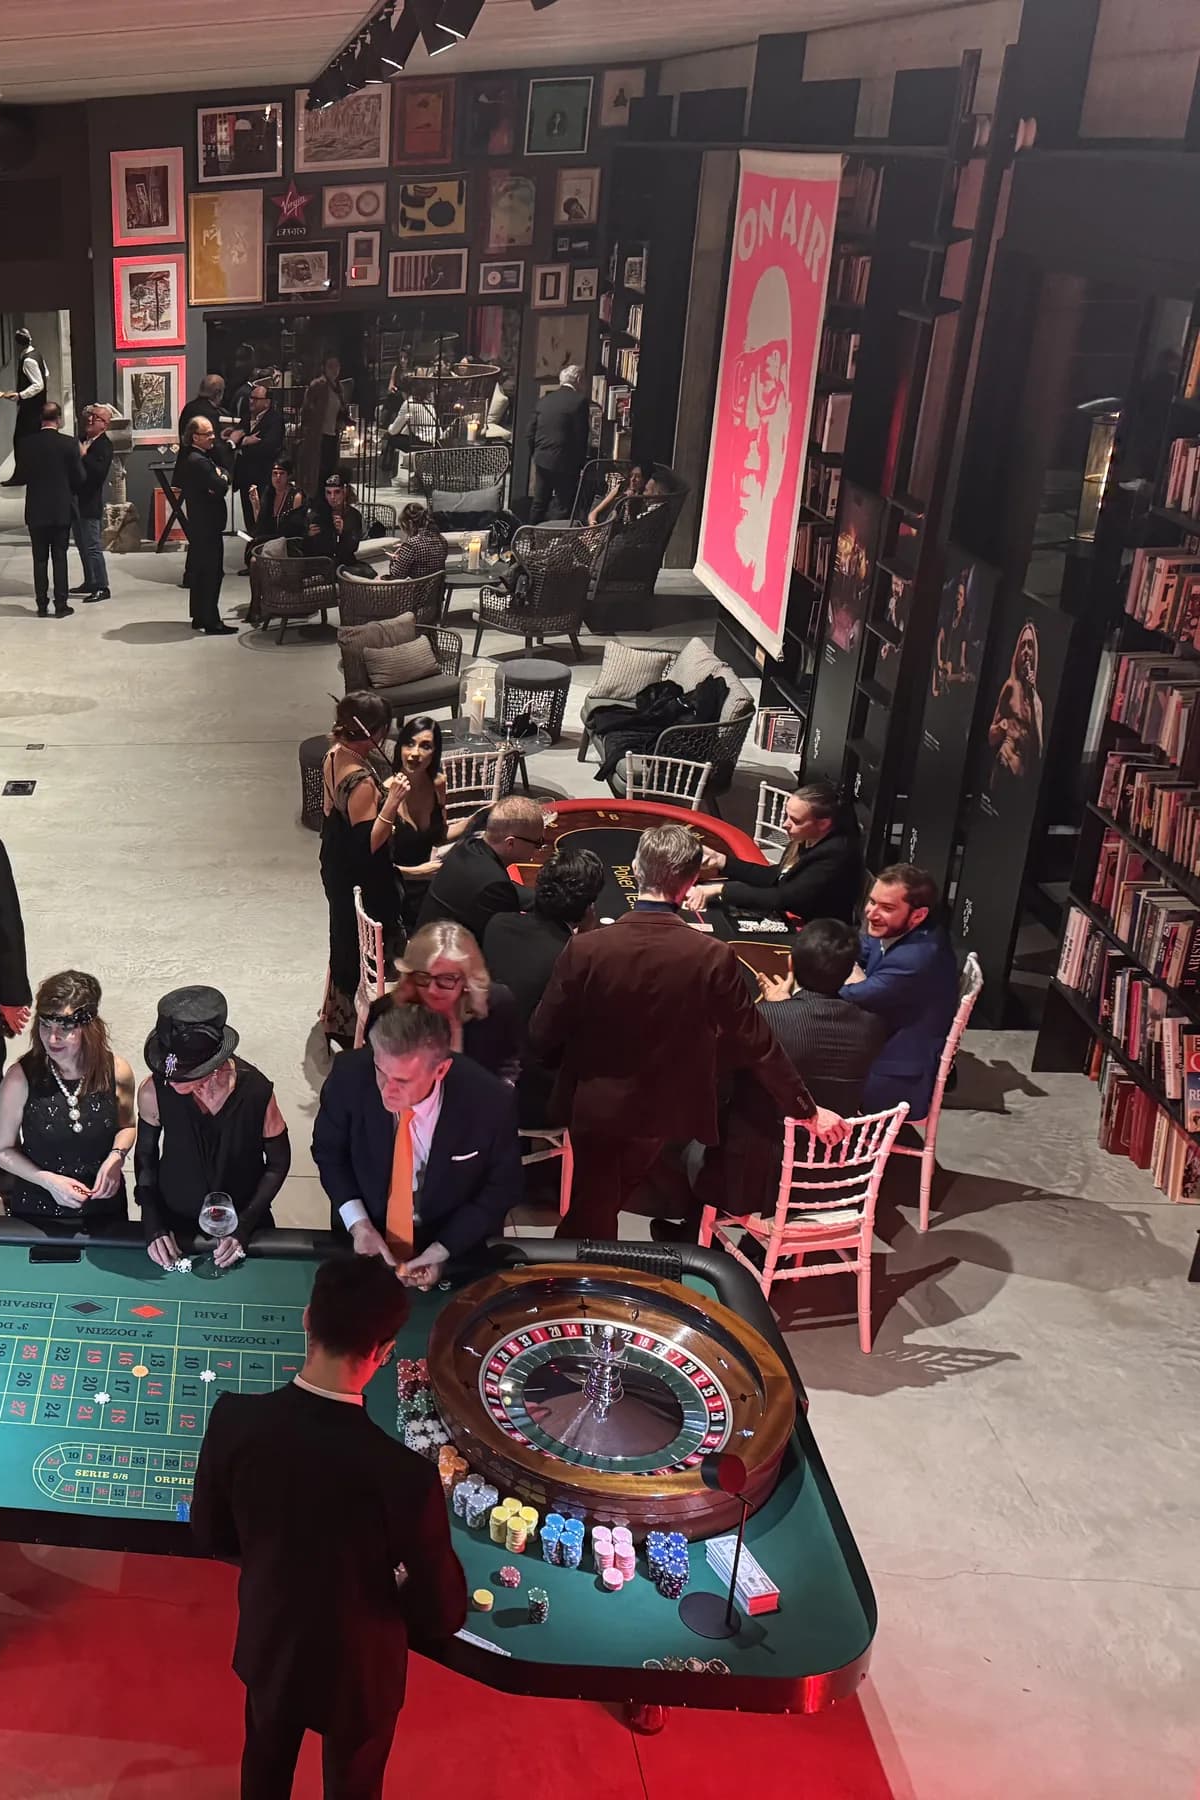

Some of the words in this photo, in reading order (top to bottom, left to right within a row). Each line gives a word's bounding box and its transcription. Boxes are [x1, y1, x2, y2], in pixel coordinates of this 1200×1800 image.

[281, 192, 306, 216] Virgin
[737, 187, 777, 261] ON
[780, 188, 826, 283] AIR
[611, 865, 636, 889] Poker
[194, 1310, 228, 1320] PARI
[76, 1326, 137, 1337] DOZZINA
[536, 1329, 543, 1340] 1
[549, 1326, 561, 1337] 20
[567, 1325, 578, 1335] 14
[584, 1325, 595, 1335] 31
[621, 1330, 633, 1342] 22
[202, 1334, 266, 1345] DOZZINA
[518, 1335, 532, 1347] 33
[638, 1335, 648, 1347] 18
[22, 1344, 39, 1359] 25
[55, 1346, 70, 1362] 22
[506, 1342, 520, 1354] 16
[655, 1343, 667, 1355] 29
[87, 1350, 103, 1364] 19
[118, 1351, 135, 1366] 16
[150, 1353, 166, 1368] 13
[184, 1355, 200, 1369] 10
[497, 1350, 511, 1362] 24
[671, 1354, 681, 1362] 7
[217, 1360, 233, 1369] 7
[249, 1362, 264, 1370] 4
[491, 1361, 503, 1370] 5
[682, 1362, 696, 1374] 28
[16, 1371, 33, 1387] 26
[50, 1373, 67, 1390] 23
[82, 1376, 98, 1392] 20
[693, 1373, 707, 1385] 12
[114, 1379, 131, 1394] 17
[147, 1381, 163, 1396] 14
[182, 1384, 198, 1397] 11
[702, 1386, 717, 1397] 35
[9, 1400, 27, 1416] 27
[44, 1402, 61, 1419] 24
[709, 1401, 722, 1409] 3
[77, 1405, 94, 1420] 21
[110, 1408, 127, 1424] 18
[143, 1411, 160, 1426] 15
[710, 1412, 724, 1422] 26
[179, 1414, 196, 1429] 12
[68, 1452, 79, 1460] 10
[100, 1455, 112, 1463] 24
[132, 1456, 145, 1465] 33
[164, 1458, 179, 1467] 20
[48, 1475, 55, 1483] 8
[74, 1469, 110, 1479] SERIE
[113, 1472, 129, 1480] 5/8
[80, 1486, 90, 1494] 11
[112, 1488, 125, 1497] 13
[155, 1491, 162, 1500] 6
